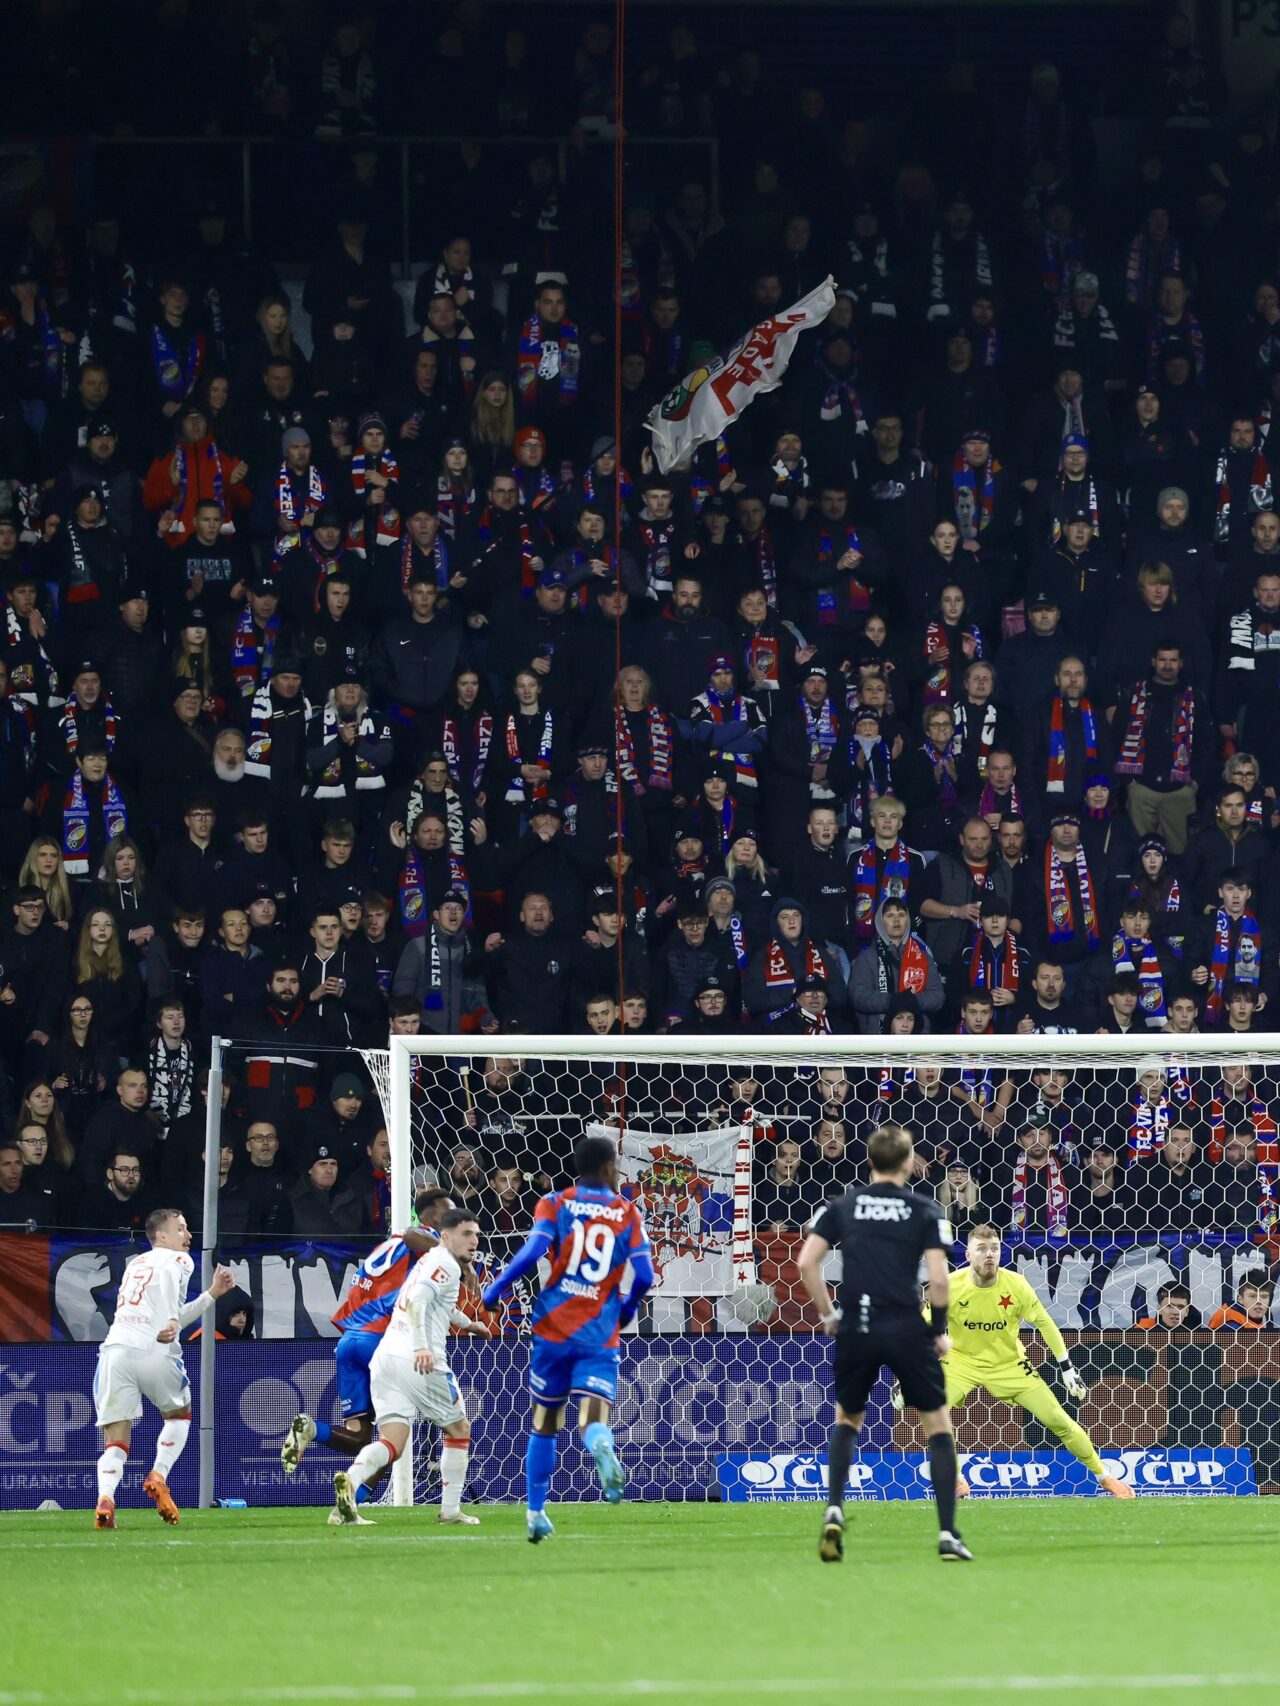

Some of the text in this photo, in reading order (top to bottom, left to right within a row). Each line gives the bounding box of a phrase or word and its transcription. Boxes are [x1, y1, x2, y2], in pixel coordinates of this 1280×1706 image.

[770, 957, 788, 977] FC
[1136, 1129, 1151, 1151] FC
[566, 1217, 616, 1284] 19
[0, 1371, 141, 1453] ČP
[242, 1471, 309, 1485] VIENNA
[969, 1457, 1051, 1487] ČPP
[1142, 1453, 1225, 1487] ČPP
[2, 1474, 145, 1489] URANCE GUP
[786, 1493, 830, 1503] INSURAN
